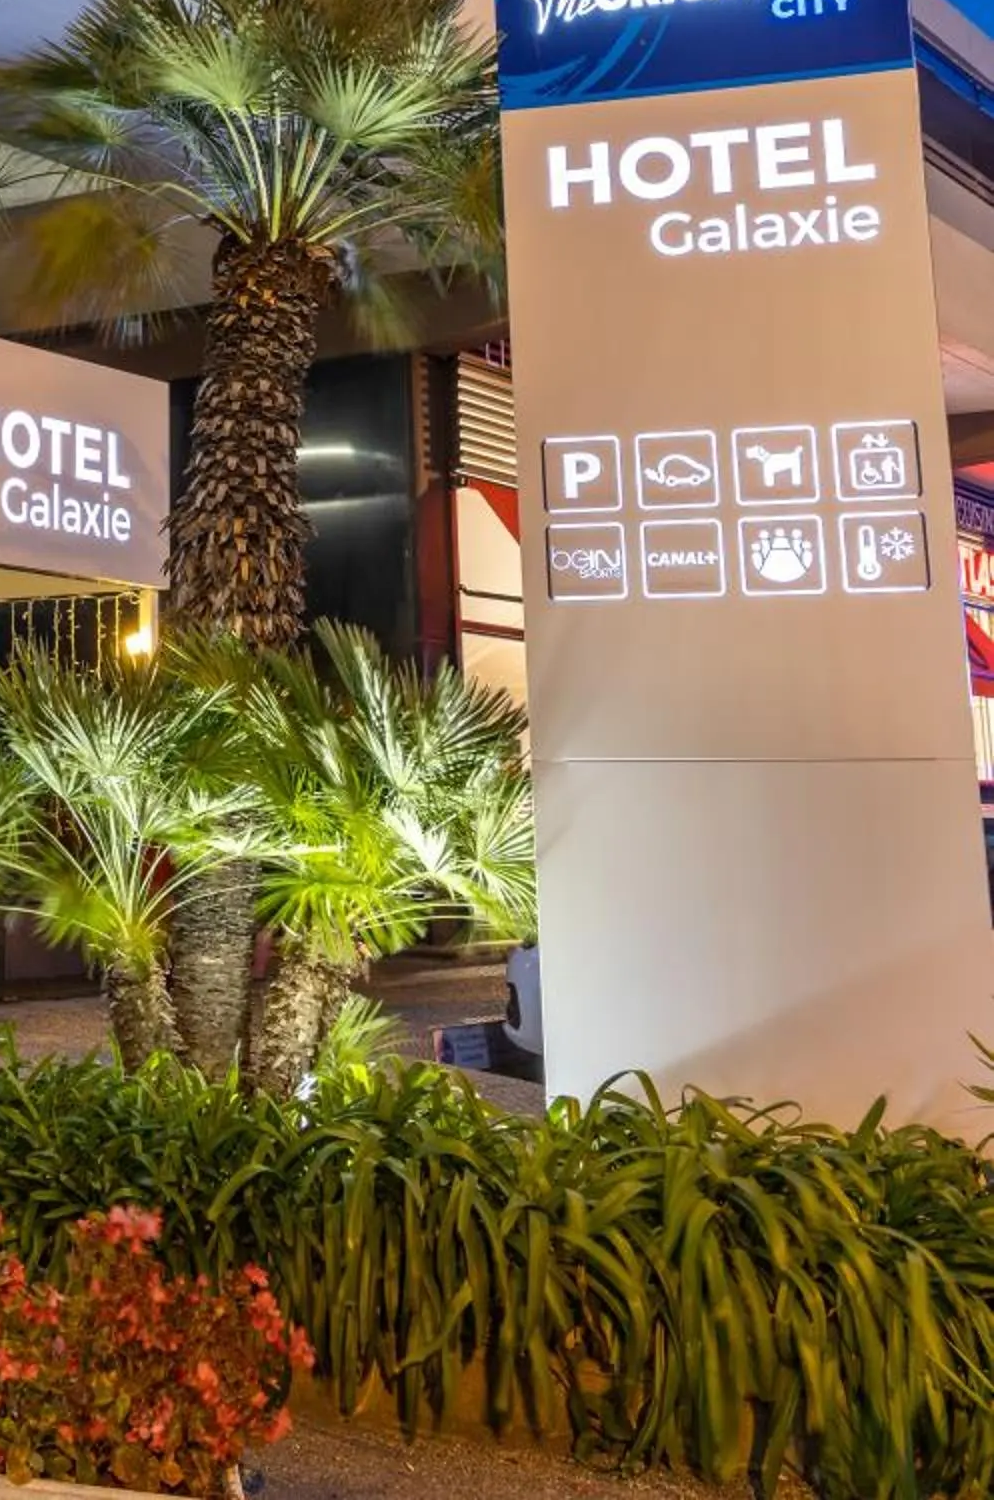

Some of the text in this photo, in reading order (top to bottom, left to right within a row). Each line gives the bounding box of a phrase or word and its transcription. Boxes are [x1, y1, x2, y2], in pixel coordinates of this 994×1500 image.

[546, 118, 878, 210] HOTEL
[649, 195, 881, 257] Galaxie
[0, 477, 133, 543] Galaxie
[646, 550, 719, 567] CANAL+
